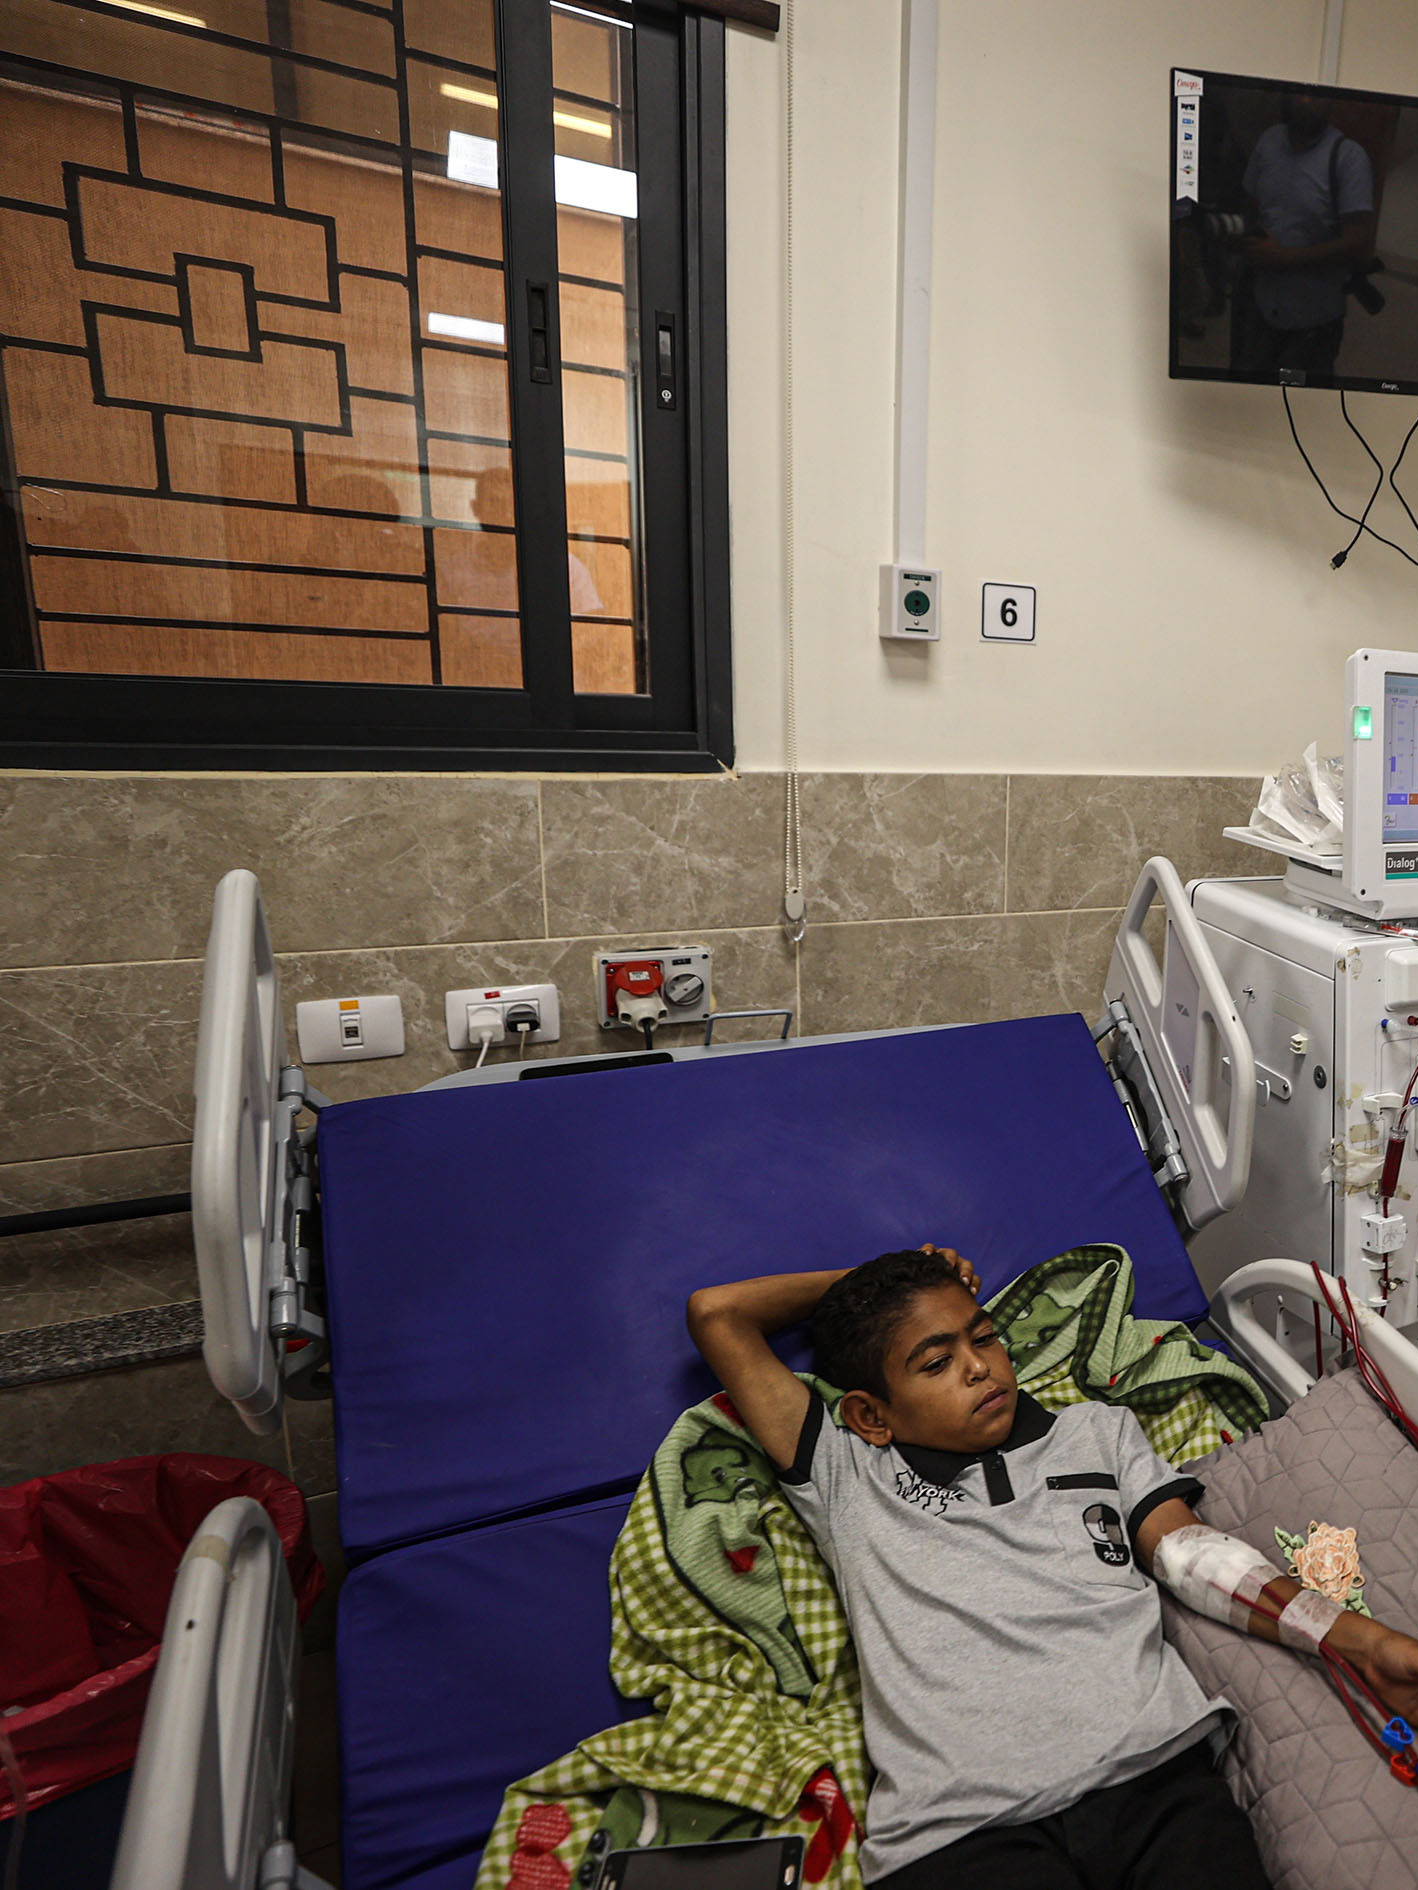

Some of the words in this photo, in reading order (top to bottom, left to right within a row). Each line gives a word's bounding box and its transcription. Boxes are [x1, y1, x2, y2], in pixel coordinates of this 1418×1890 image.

[1000, 598, 1018, 627] 6
[918, 1484, 965, 1501] YORK
[1103, 1551, 1124, 1562] POLY
